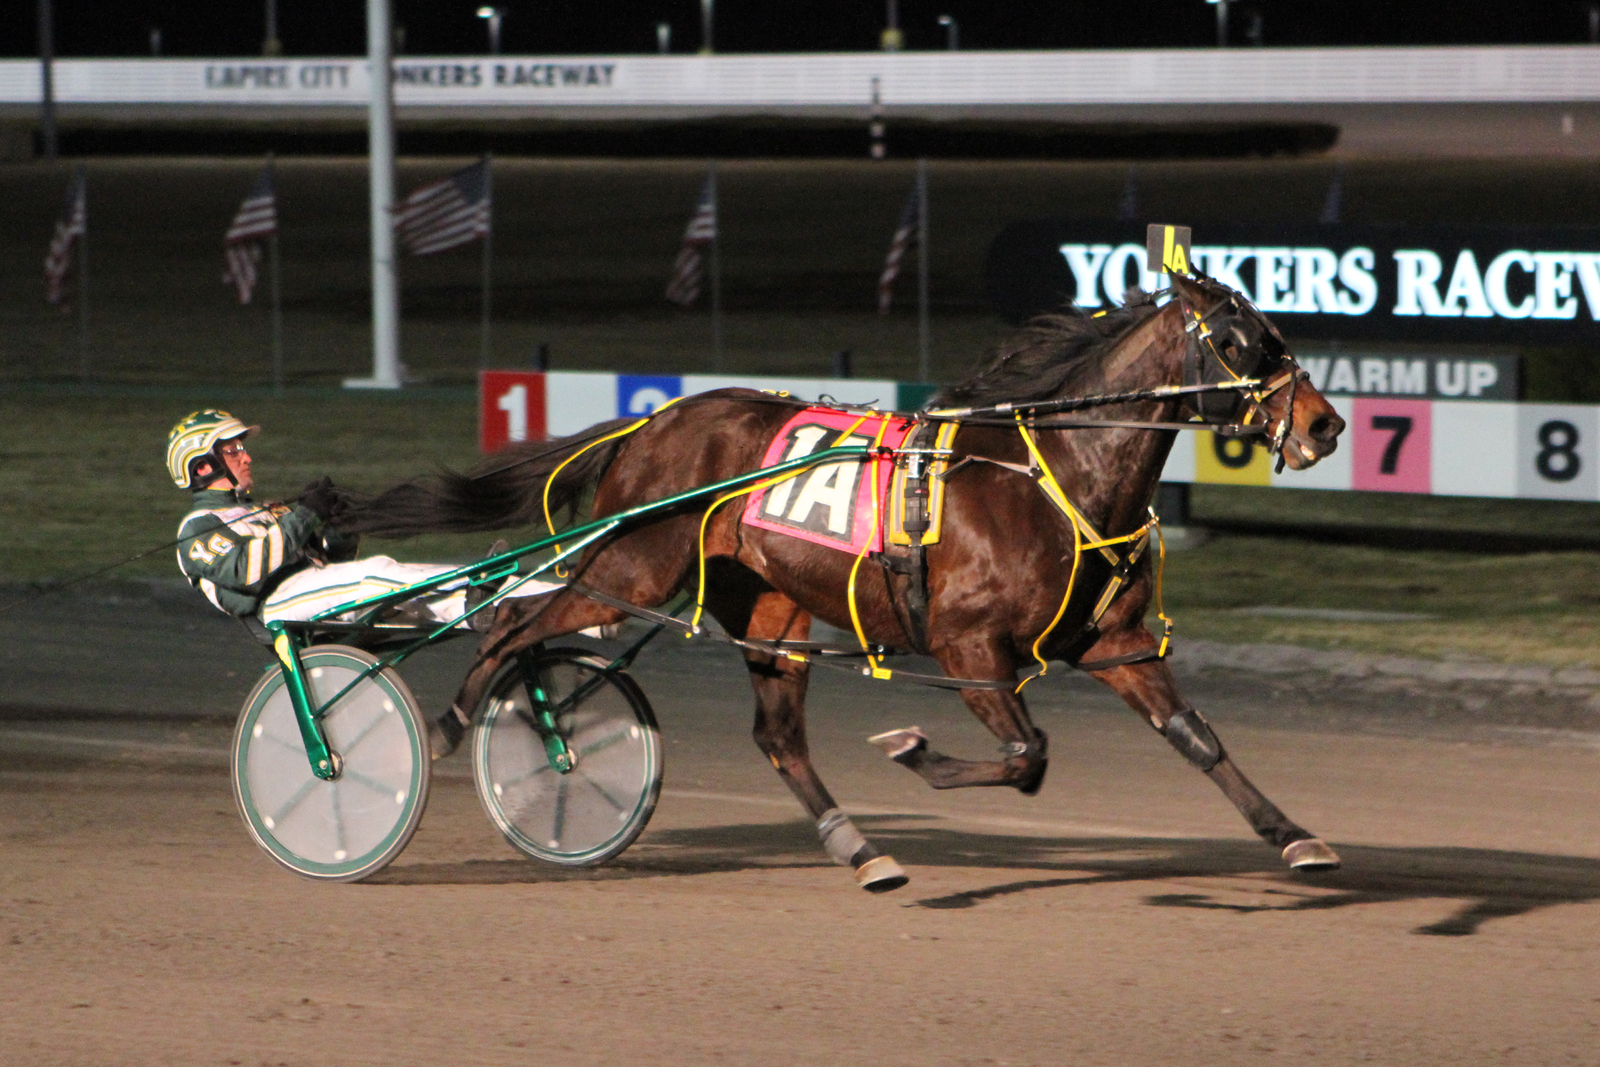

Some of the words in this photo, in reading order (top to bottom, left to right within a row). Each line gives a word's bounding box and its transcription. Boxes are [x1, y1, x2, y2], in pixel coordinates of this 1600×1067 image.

[366, 64, 483, 87] NKERS
[493, 63, 615, 87] RACEWAY
[1296, 358, 1427, 395] WARM
[1434, 361, 1498, 397] UP
[497, 384, 529, 441] 1
[1369, 415, 1414, 476] 7
[1534, 420, 1582, 482] 8
[765, 425, 869, 535] 1A
